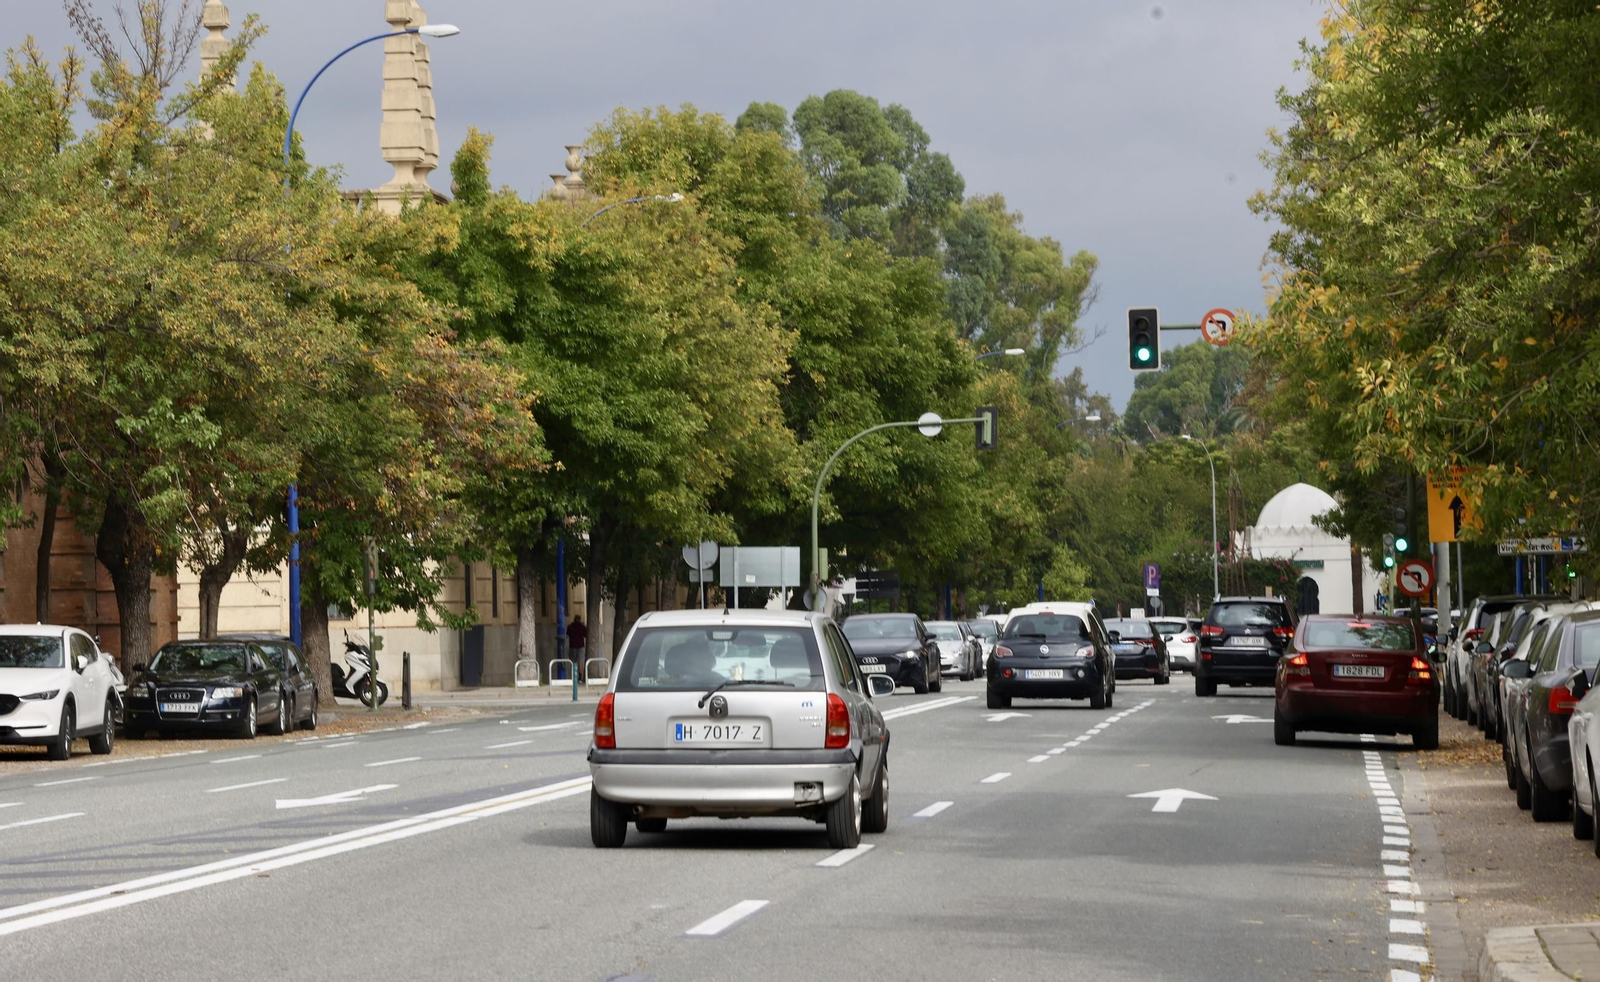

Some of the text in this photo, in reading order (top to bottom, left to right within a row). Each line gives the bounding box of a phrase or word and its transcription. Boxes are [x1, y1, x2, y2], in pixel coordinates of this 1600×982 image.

[1148, 566, 1156, 585] P
[1342, 666, 1382, 676] 1828 FDL
[703, 725, 741, 740] 7017
[752, 725, 761, 740] Z
